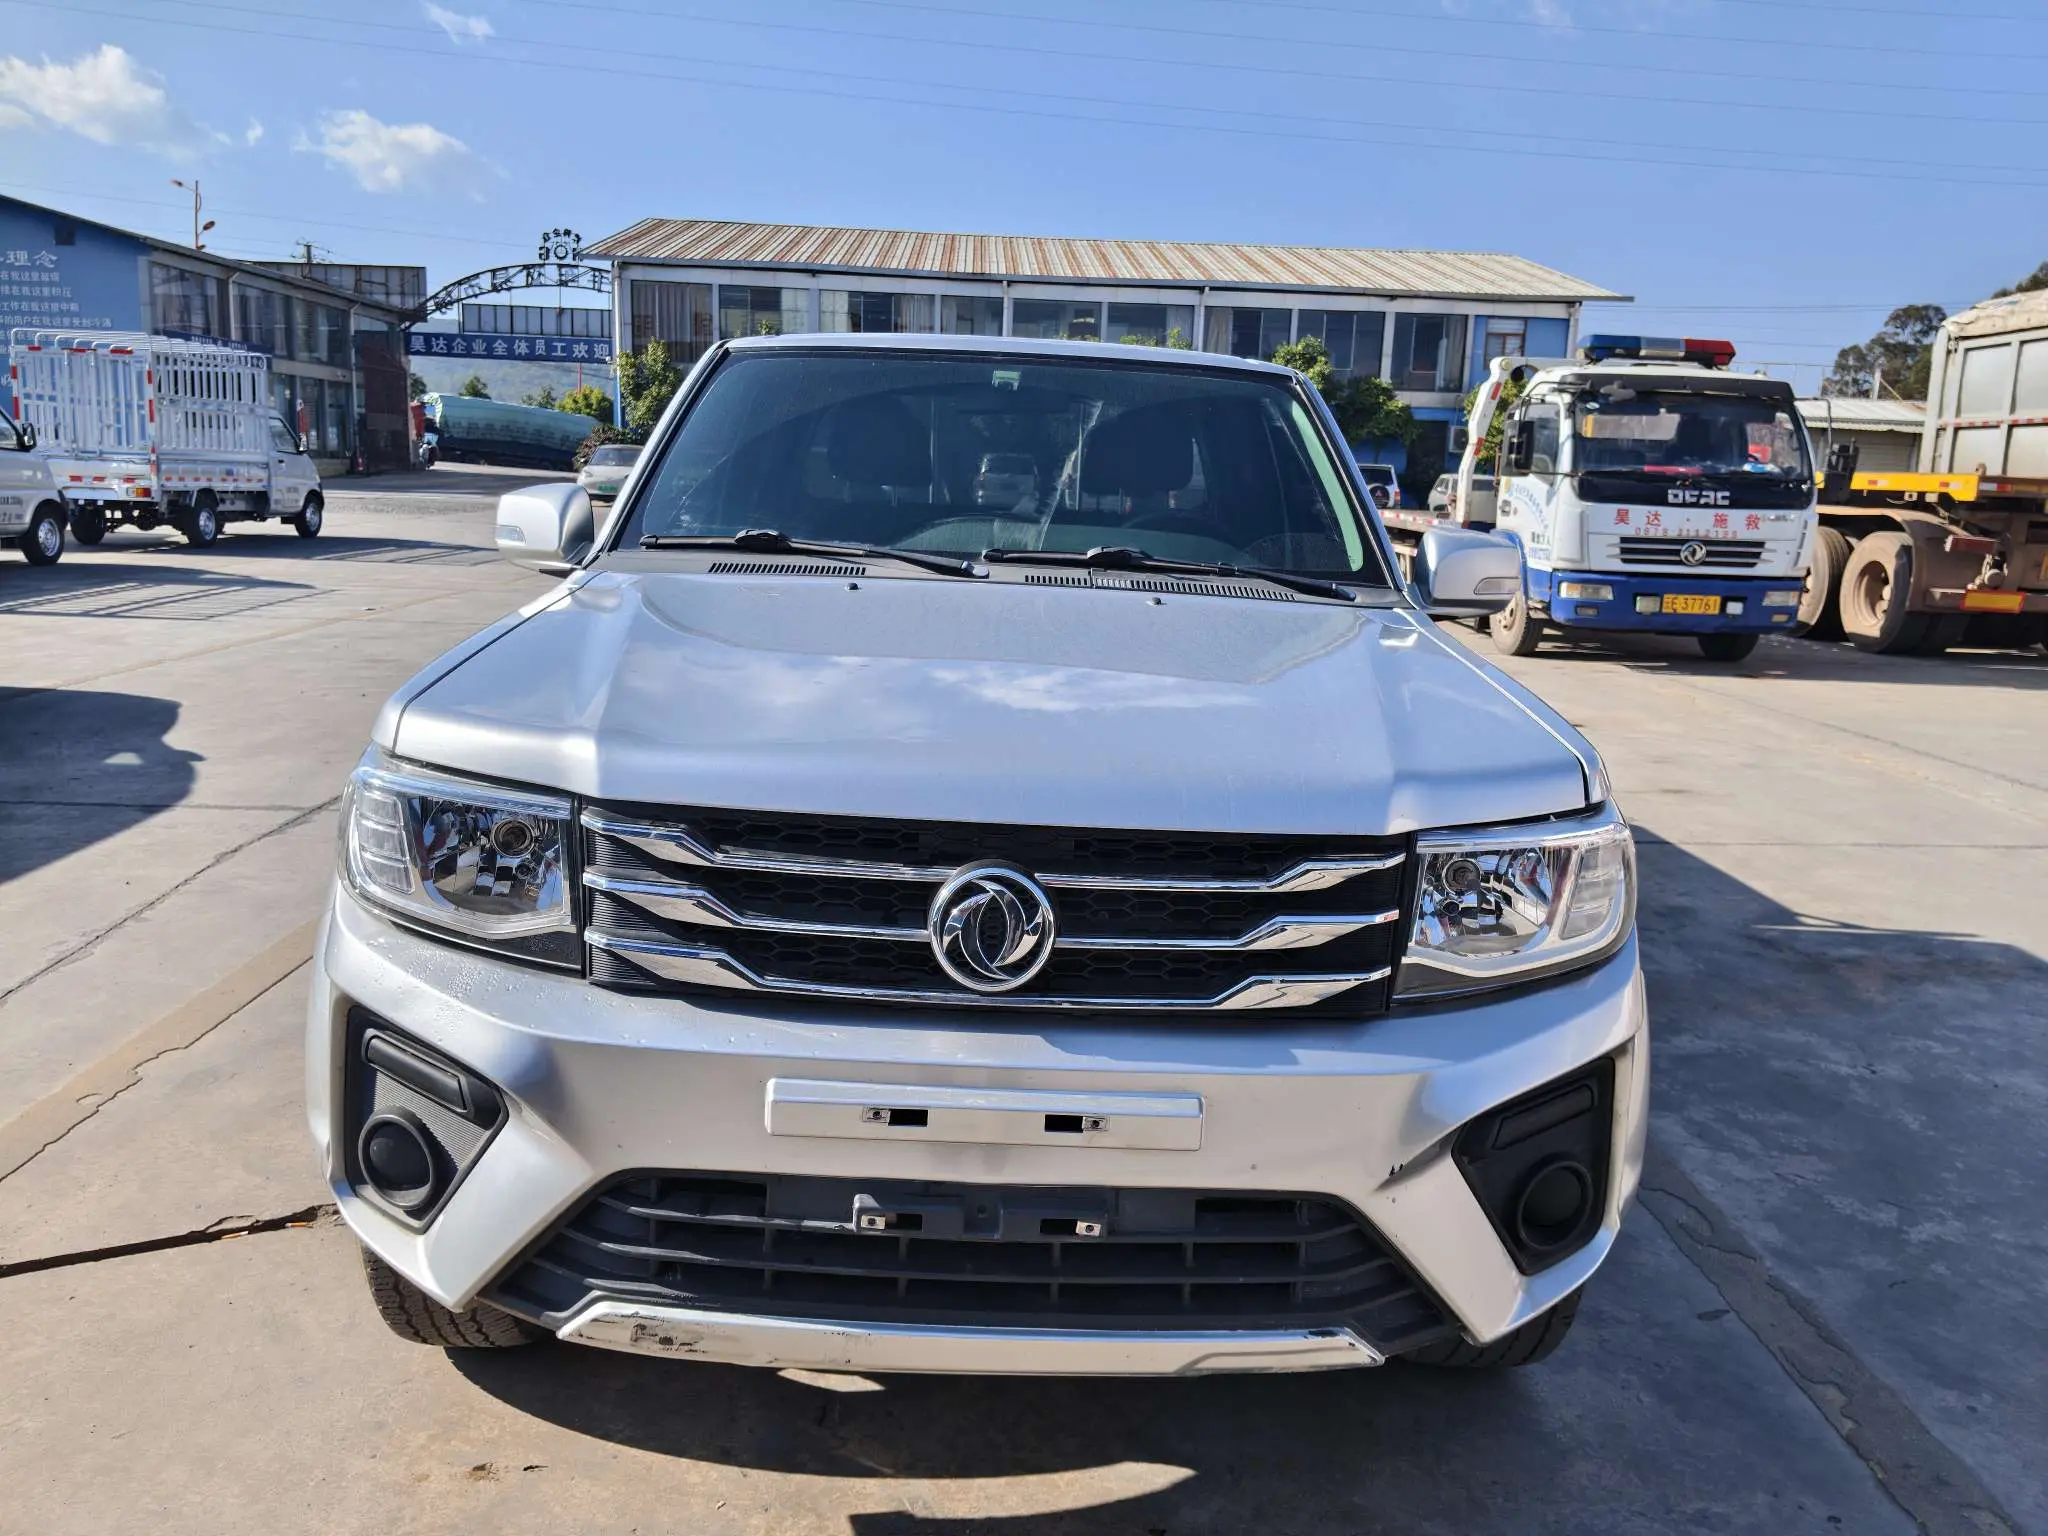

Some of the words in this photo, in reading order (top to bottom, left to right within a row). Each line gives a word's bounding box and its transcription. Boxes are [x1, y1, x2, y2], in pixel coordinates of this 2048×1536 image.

[0, 250, 58, 268] 理念
[410, 335, 611, 359] 昊达企业全体员工欢迎
[1667, 488, 1731, 506] DFAC
